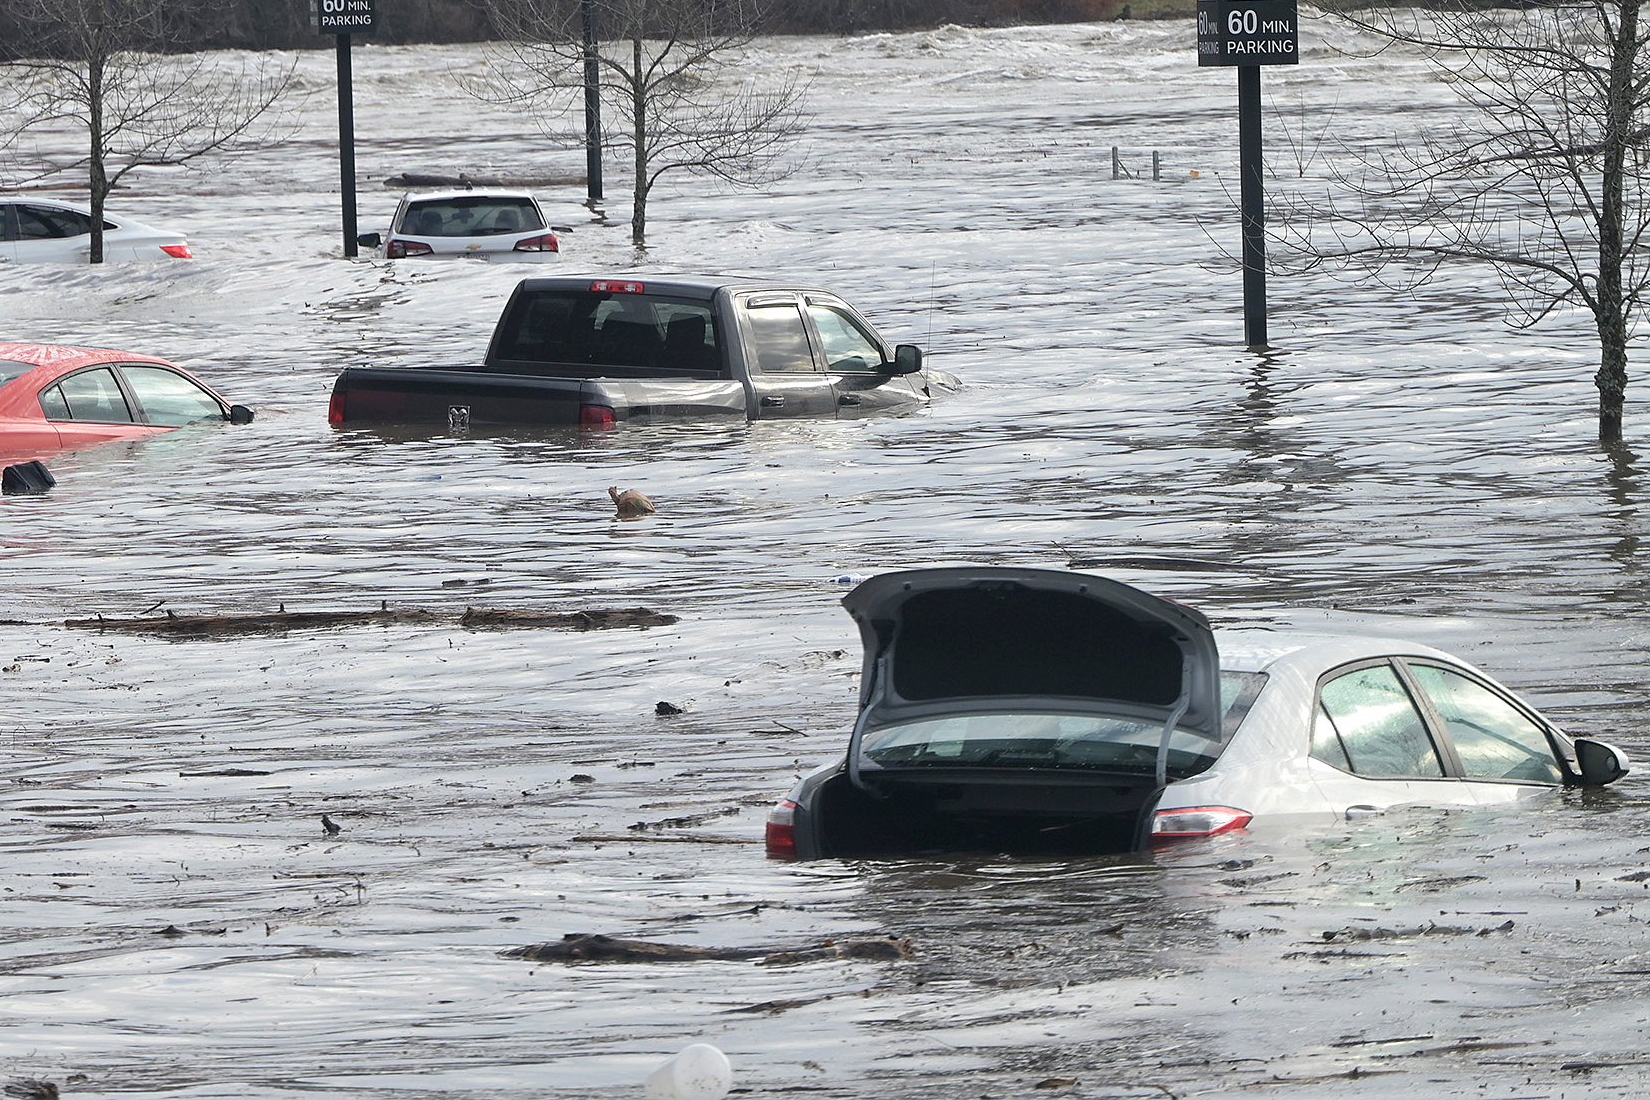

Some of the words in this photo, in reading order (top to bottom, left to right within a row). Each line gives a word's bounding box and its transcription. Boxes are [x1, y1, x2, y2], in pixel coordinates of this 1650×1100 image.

[347, 1, 371, 11] MIN.
[322, 15, 372, 26] PARKING
[1198, 11, 1208, 35] 60
[1227, 9, 1258, 35] 60
[1262, 20, 1293, 33] MIN.
[1198, 41, 1220, 55] PARKING
[1227, 39, 1294, 54] PARKING
